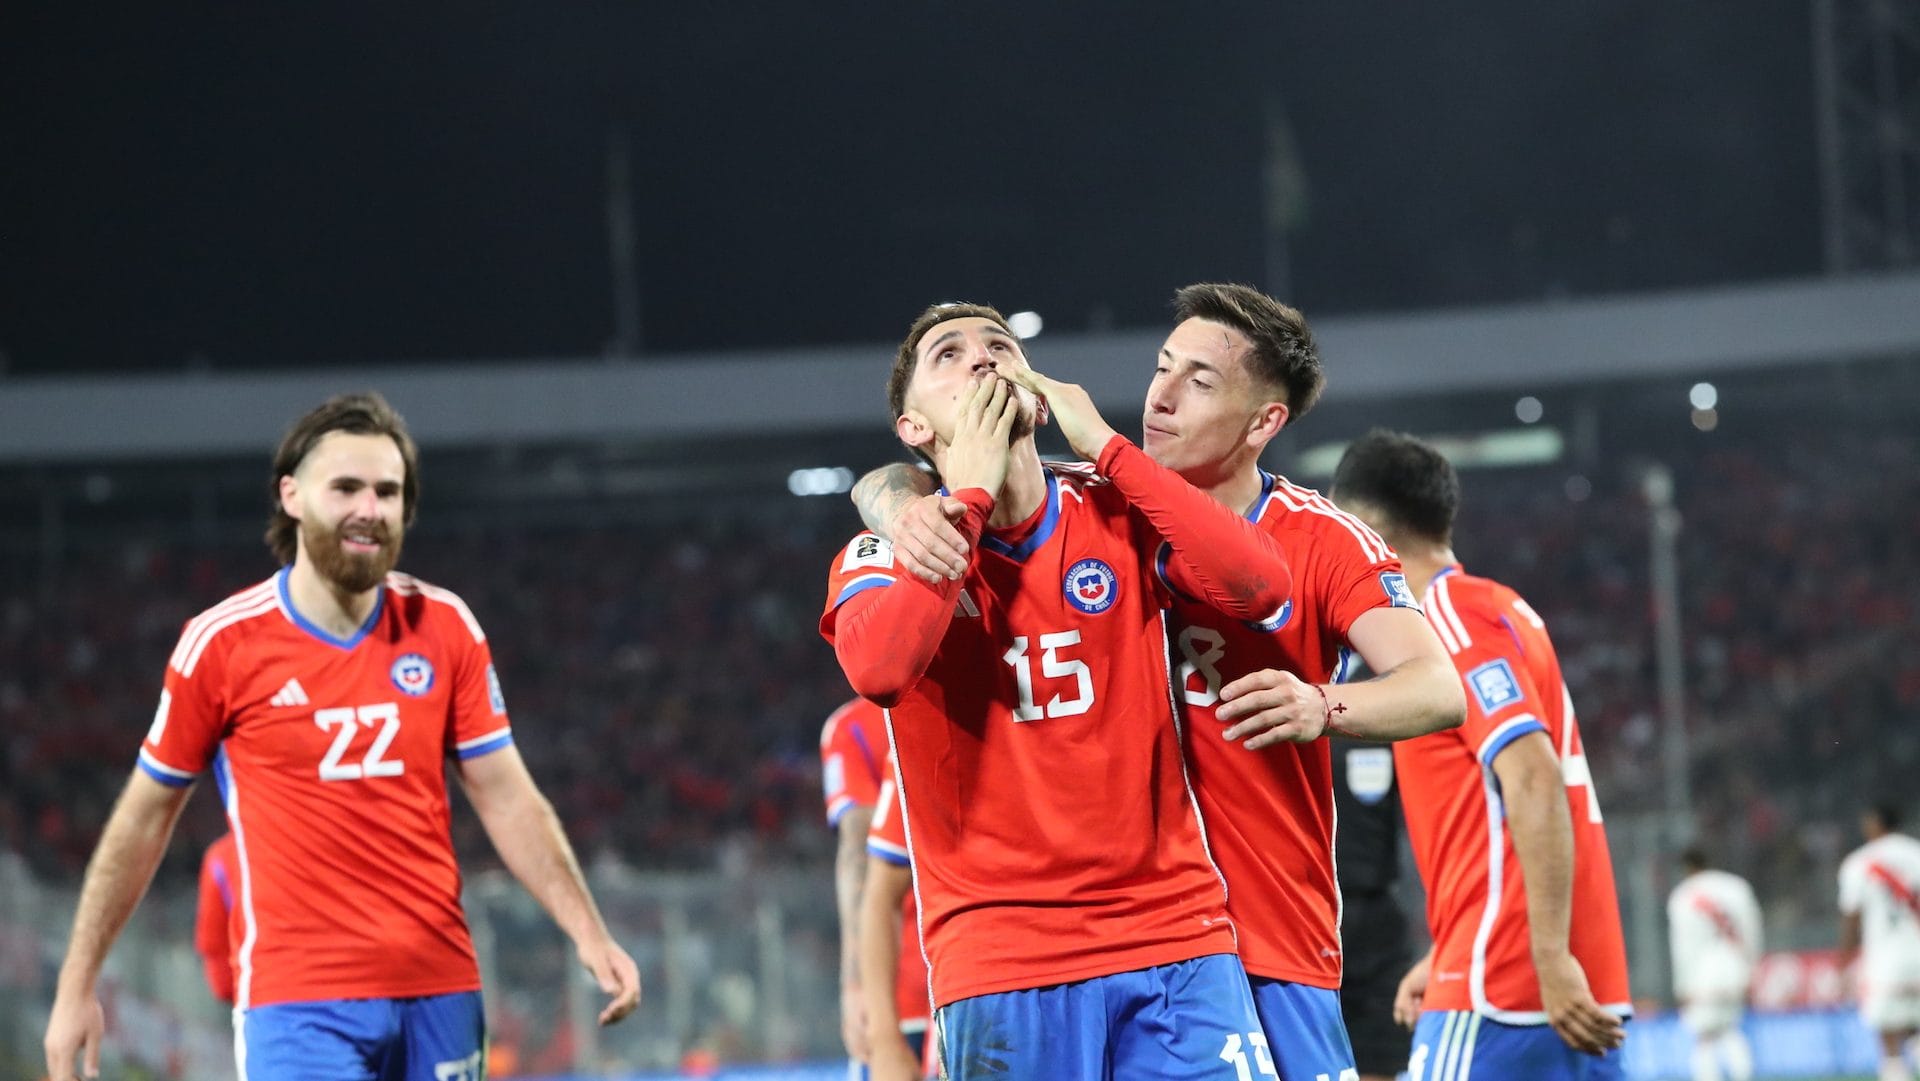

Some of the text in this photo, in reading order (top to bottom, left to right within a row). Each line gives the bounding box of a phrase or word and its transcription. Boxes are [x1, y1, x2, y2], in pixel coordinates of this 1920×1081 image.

[1095, 600, 1110, 611] CHILE
[1002, 629, 1095, 723] 15
[1177, 626, 1225, 707] 8
[314, 702, 405, 781] 22
